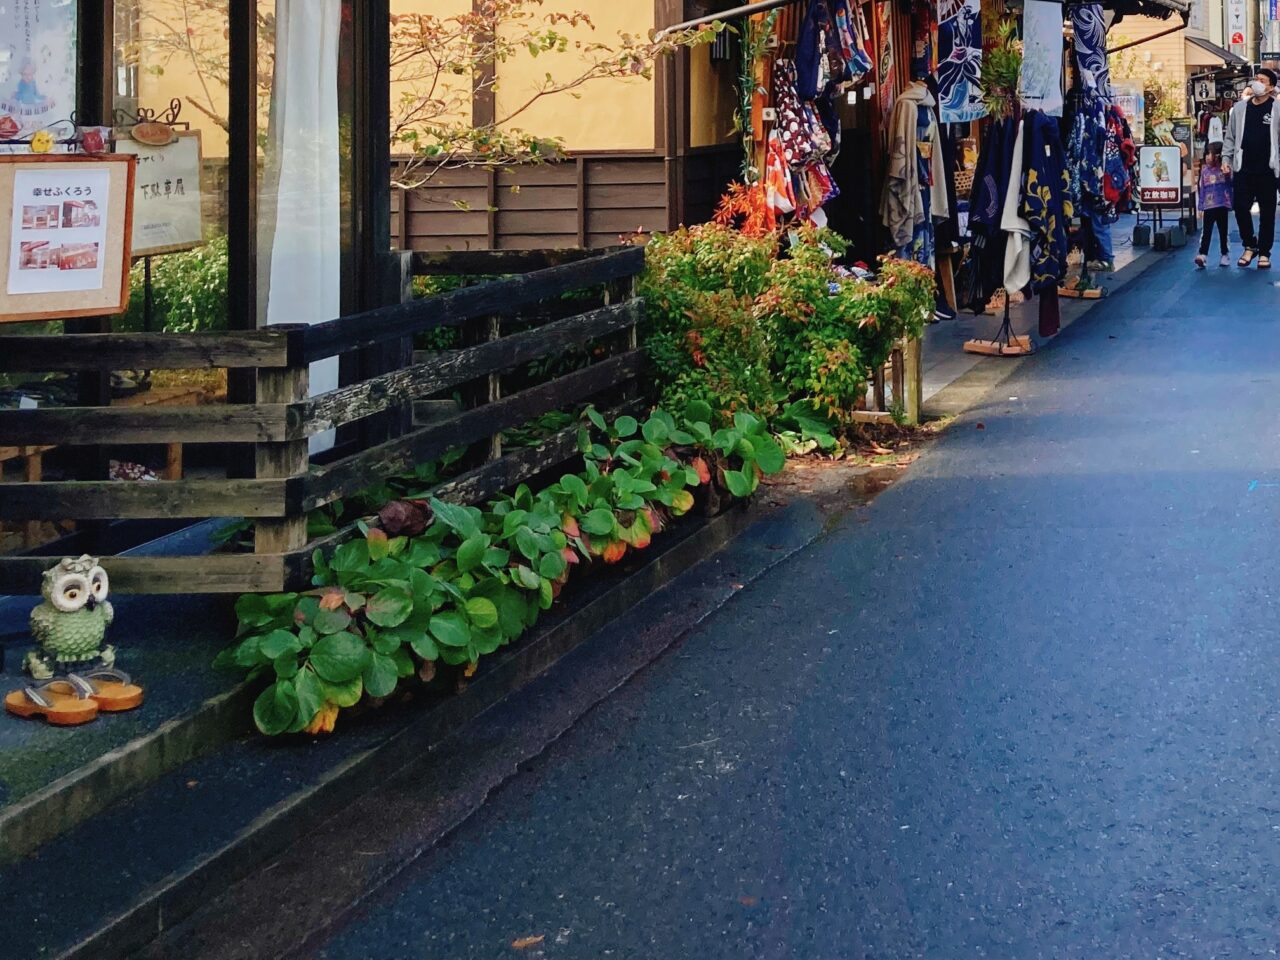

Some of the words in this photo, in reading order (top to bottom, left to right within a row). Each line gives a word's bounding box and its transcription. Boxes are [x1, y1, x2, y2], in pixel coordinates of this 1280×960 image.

[33, 186, 92, 197] 幸せふくろう
[1143, 190, 1176, 200] 立飲珈琲
